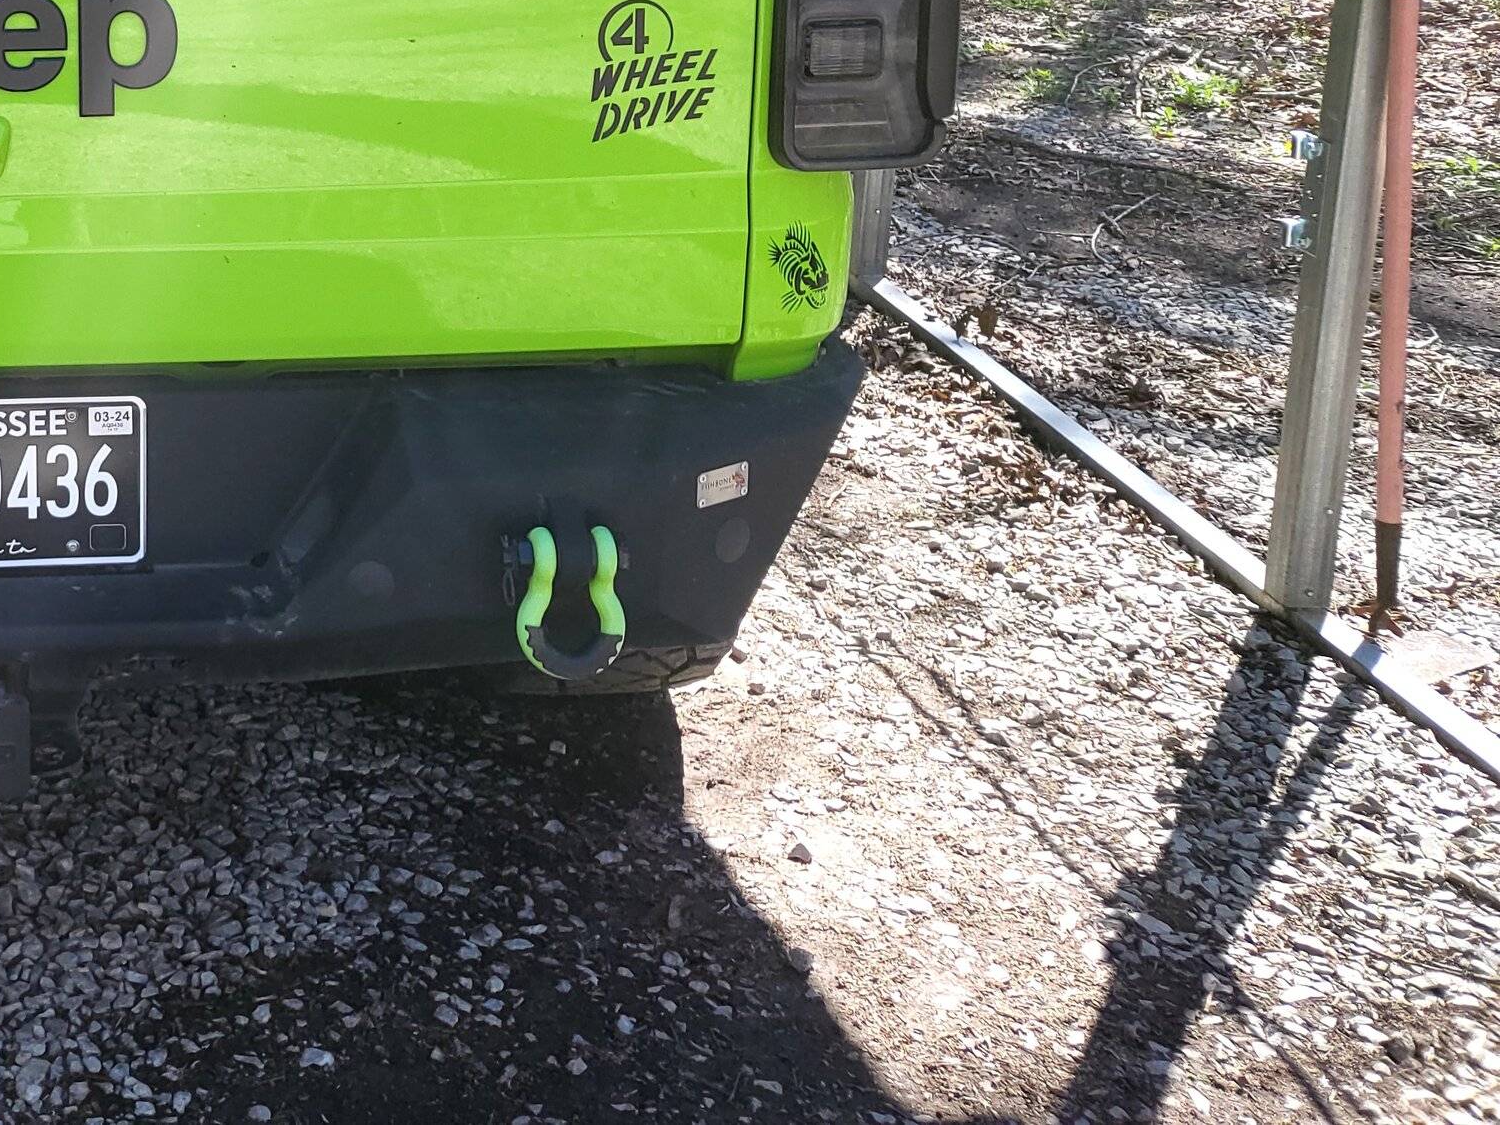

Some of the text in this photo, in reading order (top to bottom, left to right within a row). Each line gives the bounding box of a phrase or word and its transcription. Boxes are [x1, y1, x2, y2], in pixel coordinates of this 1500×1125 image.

[610, 8, 649, 54] 4
[591, 48, 718, 102] WHEEL
[592, 87, 715, 143] DRIVE
[94, 410, 131, 423] 03-24
